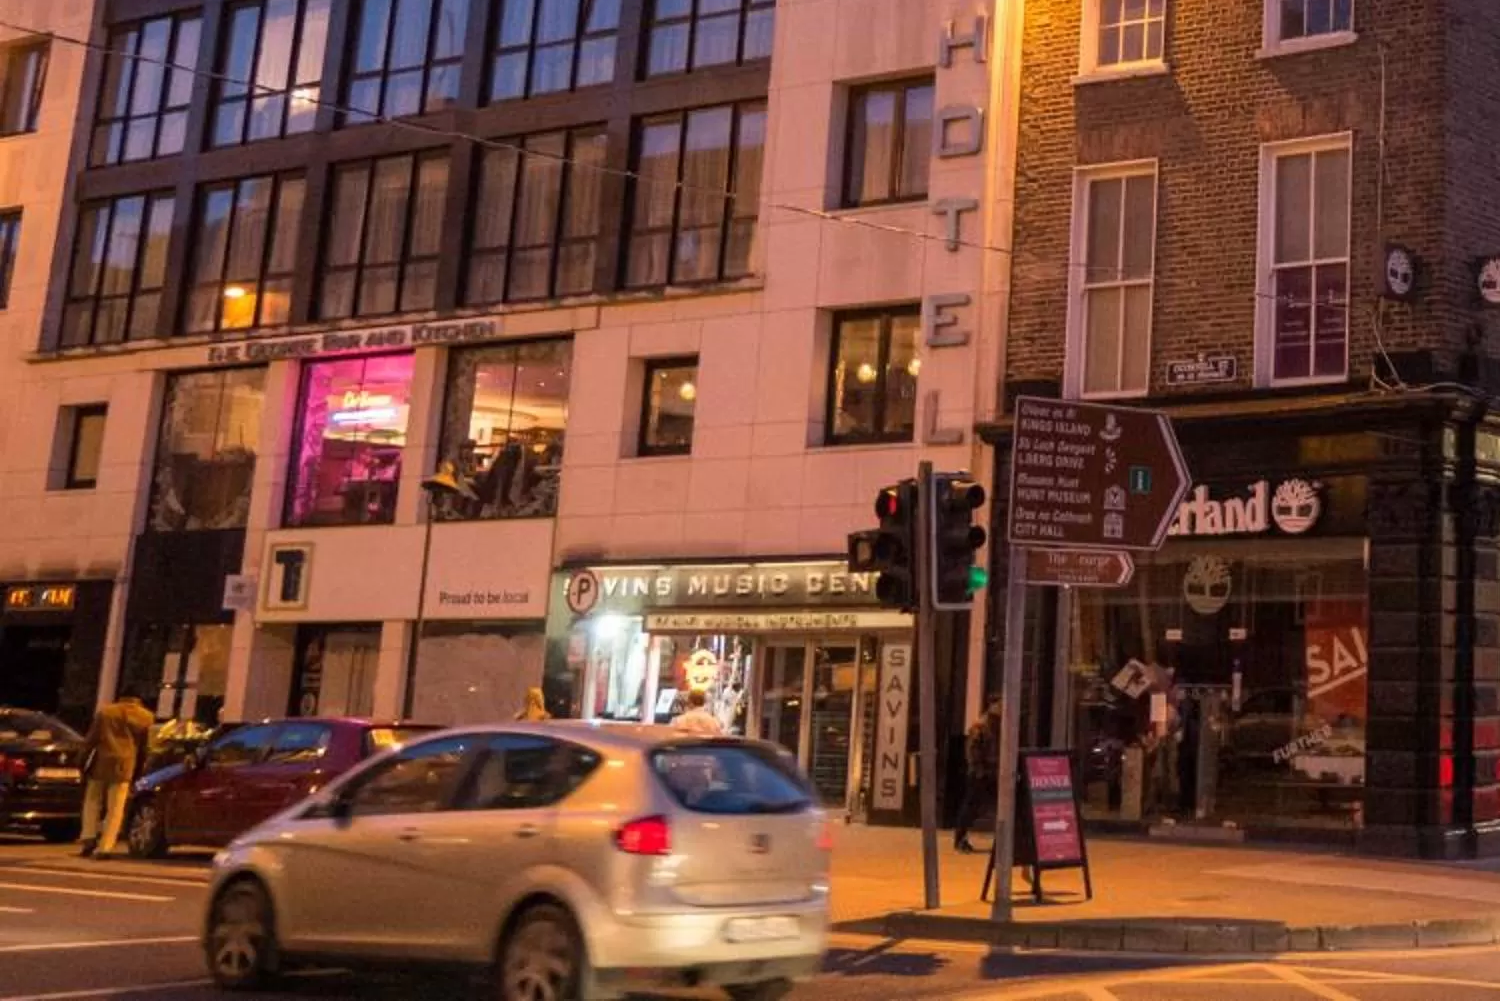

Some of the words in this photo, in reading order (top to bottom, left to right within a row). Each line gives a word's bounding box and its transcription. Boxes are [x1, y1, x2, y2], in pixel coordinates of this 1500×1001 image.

[921, 14, 988, 446] HOTEL
[1020, 418, 1054, 433] KINGS
[1055, 421, 1092, 437] ISLAND
[1055, 455, 1085, 470] DRIVE
[1016, 487, 1046, 502] HUNT
[1047, 490, 1092, 505] MUSEUM
[1168, 480, 1269, 536] rland
[1014, 521, 1037, 537] CITY
[1038, 524, 1065, 539] HALL
[686, 571, 790, 597] MUSIC
[439, 590, 472, 605] Proud
[487, 591, 500, 604] be
[502, 589, 529, 604] local
[880, 648, 907, 798] SAVINS
